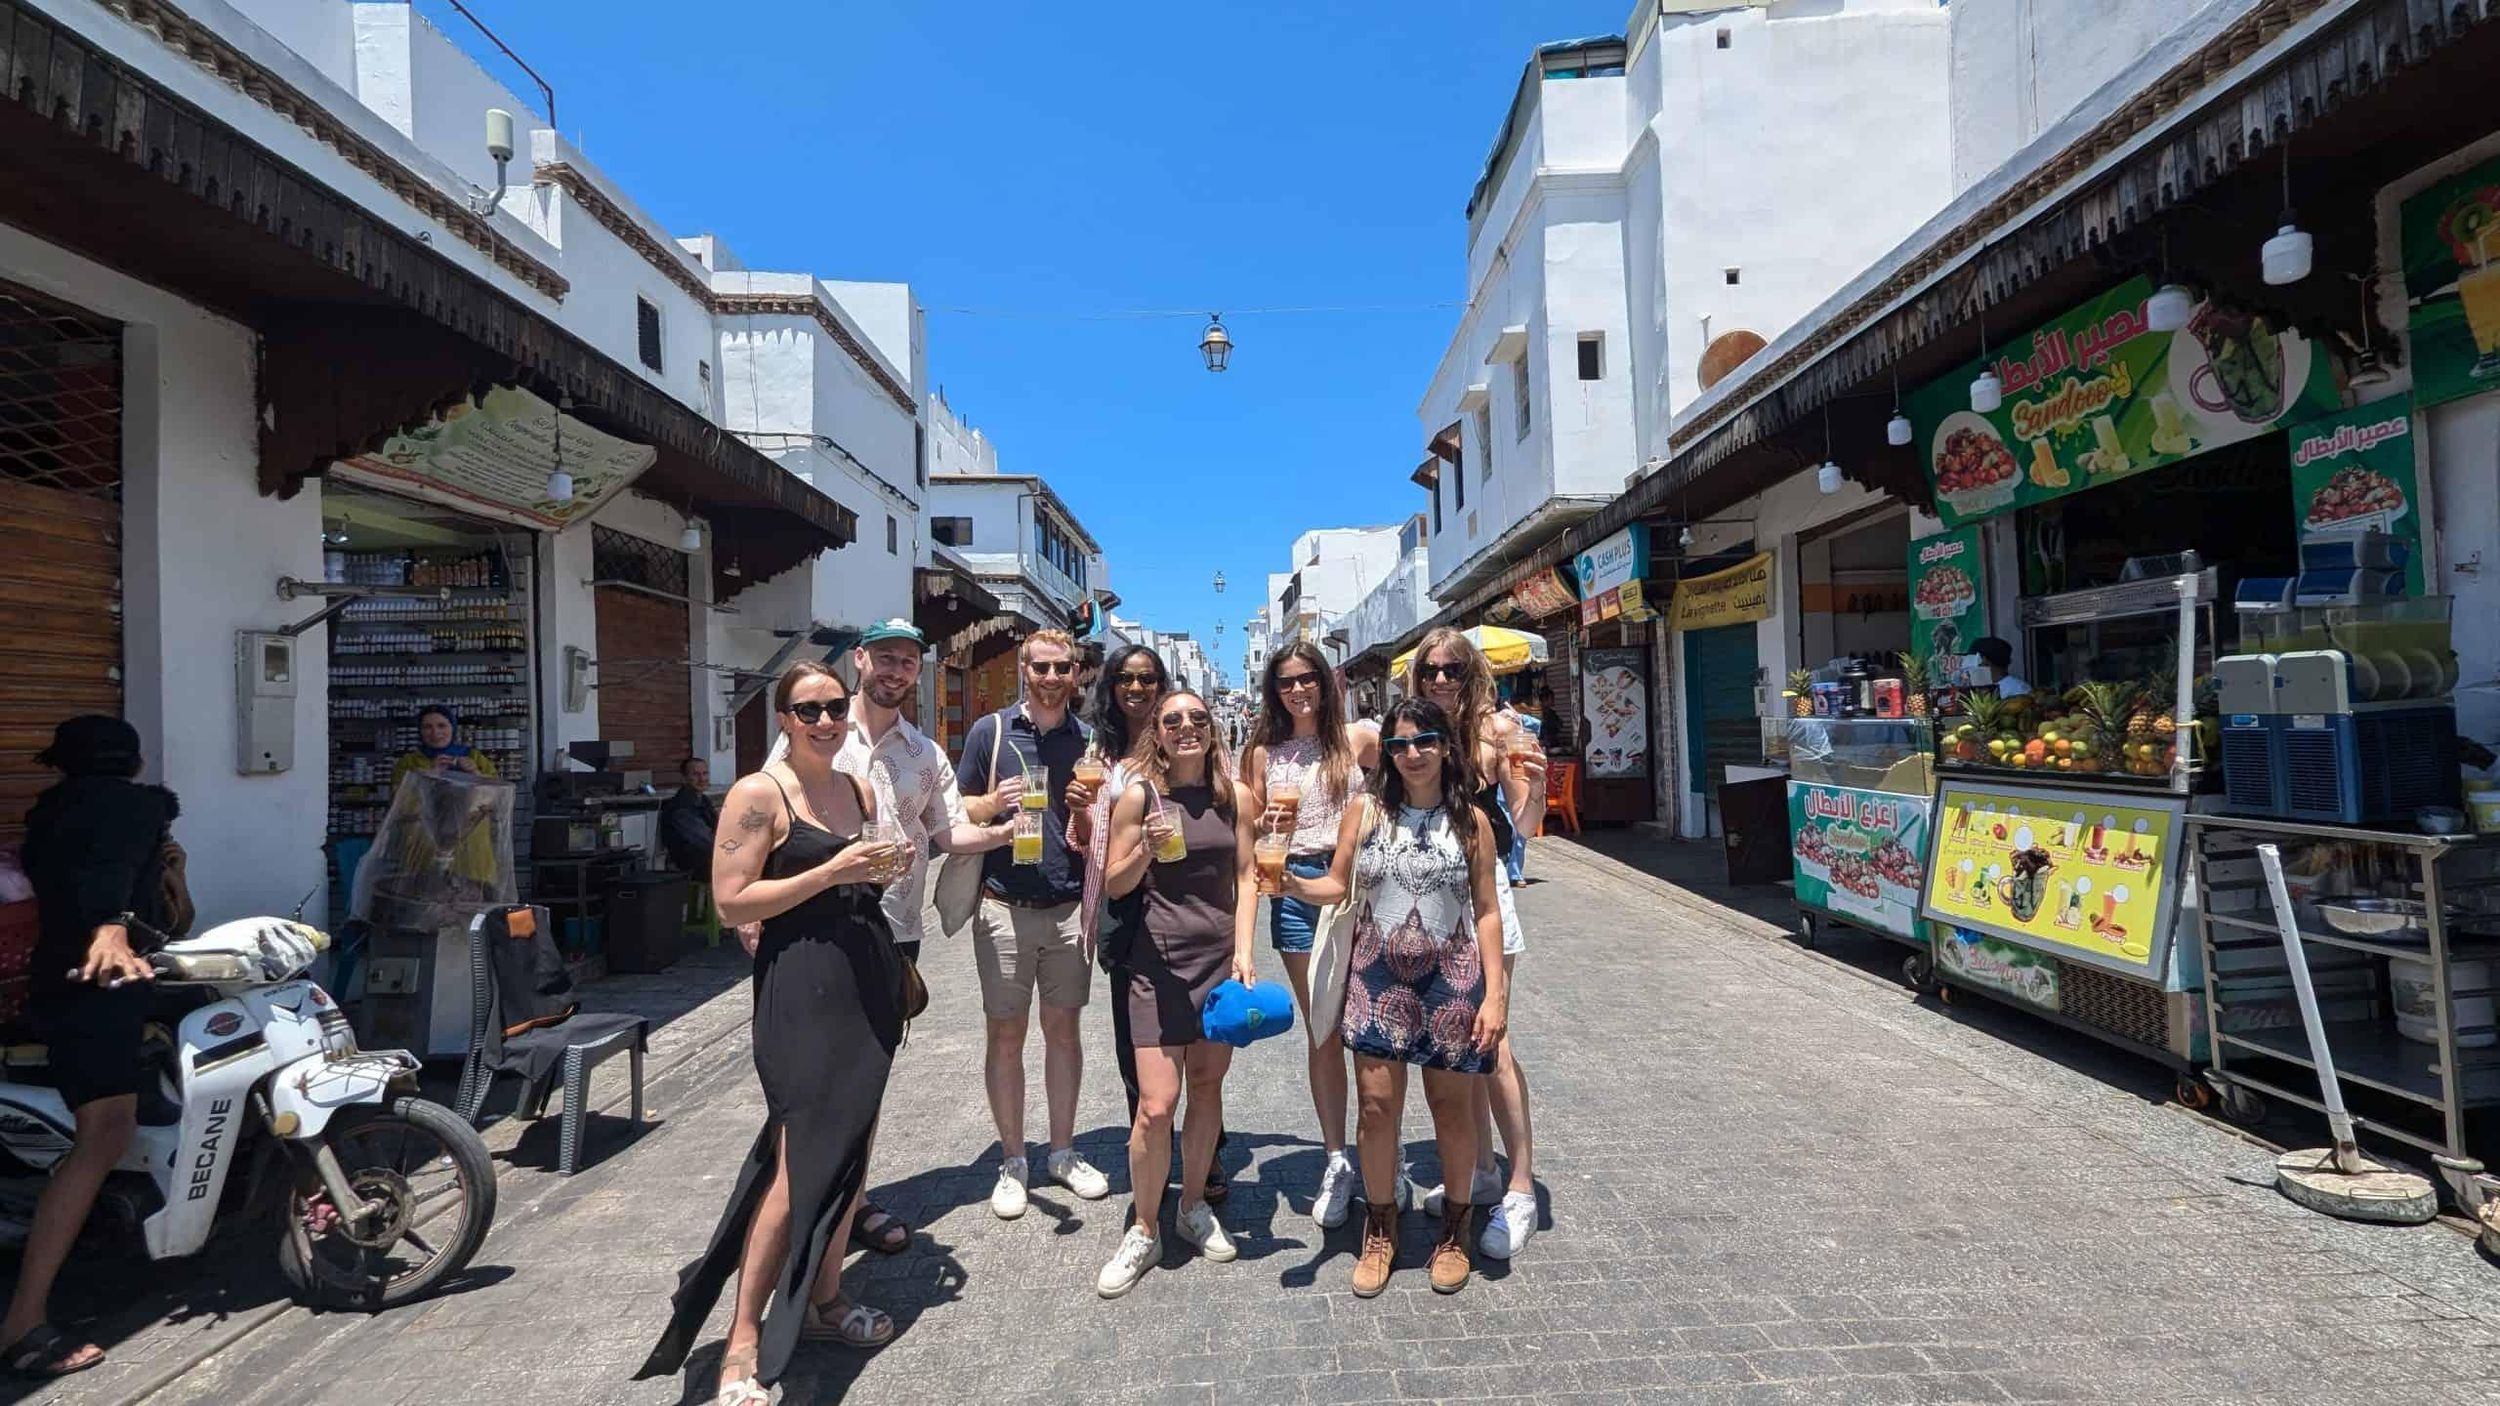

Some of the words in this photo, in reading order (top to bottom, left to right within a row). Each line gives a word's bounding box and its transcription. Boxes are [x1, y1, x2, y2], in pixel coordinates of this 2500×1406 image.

[1991, 328, 2072, 396] الأبط
[2295, 424, 2356, 466] الأبطال
[2356, 417, 2408, 451] عصير
[1597, 548, 1614, 569] CASH
[1614, 538, 1632, 562] PLUS
[187, 1098, 232, 1201] BECANE
